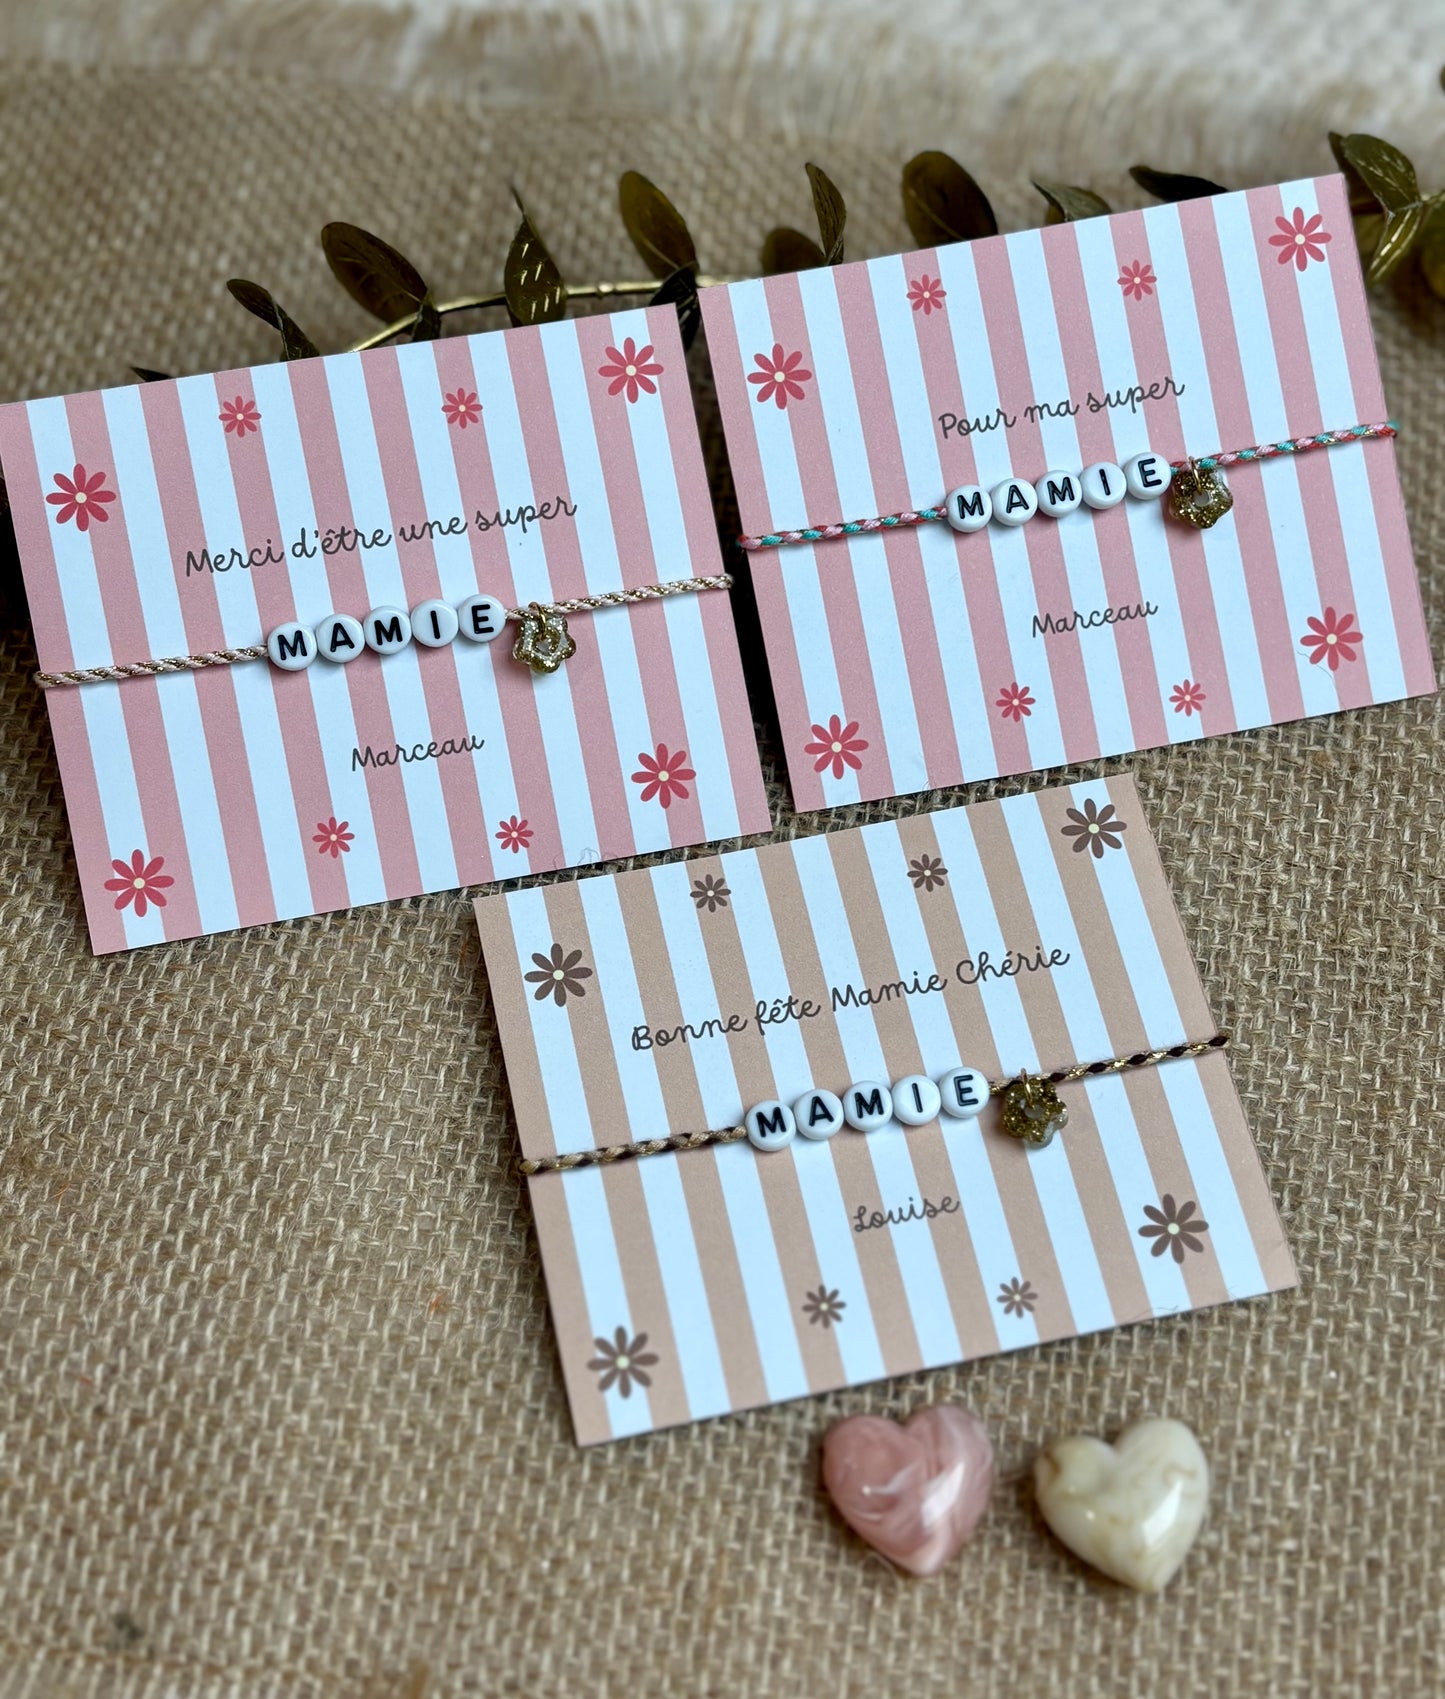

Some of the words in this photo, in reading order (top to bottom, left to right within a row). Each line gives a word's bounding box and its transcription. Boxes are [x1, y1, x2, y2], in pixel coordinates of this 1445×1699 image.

[938, 408, 1017, 439] Pour
[1024, 400, 1080, 423] ma
[1086, 376, 1185, 413] super
[957, 458, 1163, 519] MAMIE
[186, 538, 285, 577] Merci
[291, 525, 392, 558] d'être
[398, 517, 469, 543] une
[475, 496, 577, 533] super
[277, 603, 495, 661] MAMIE
[1032, 601, 1159, 638] Marceau
[352, 734, 485, 771] Marceau
[631, 1014, 748, 1051] Bonne
[754, 995, 822, 1036] fête
[832, 970, 948, 1012] Mamie
[955, 945, 1070, 985] Chérie
[756, 1074, 979, 1138] MAMIE
[853, 1196, 960, 1233] Louise
